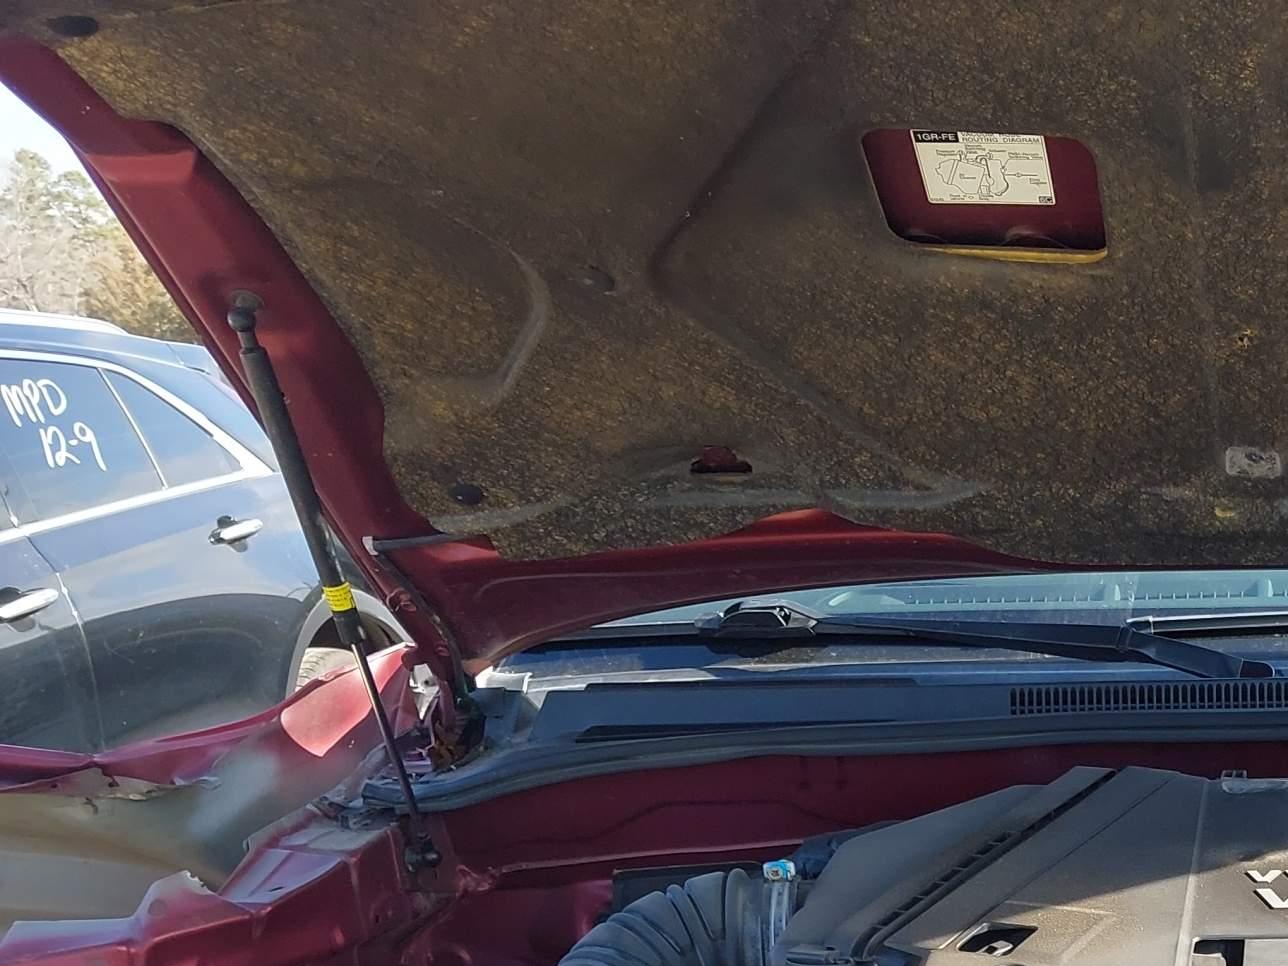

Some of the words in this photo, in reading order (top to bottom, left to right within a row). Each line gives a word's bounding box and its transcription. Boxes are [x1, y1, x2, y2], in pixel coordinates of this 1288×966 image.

[917, 132, 956, 141] 1GR-FE
[1, 379, 67, 427] MPD
[39, 422, 107, 471] 12-9
